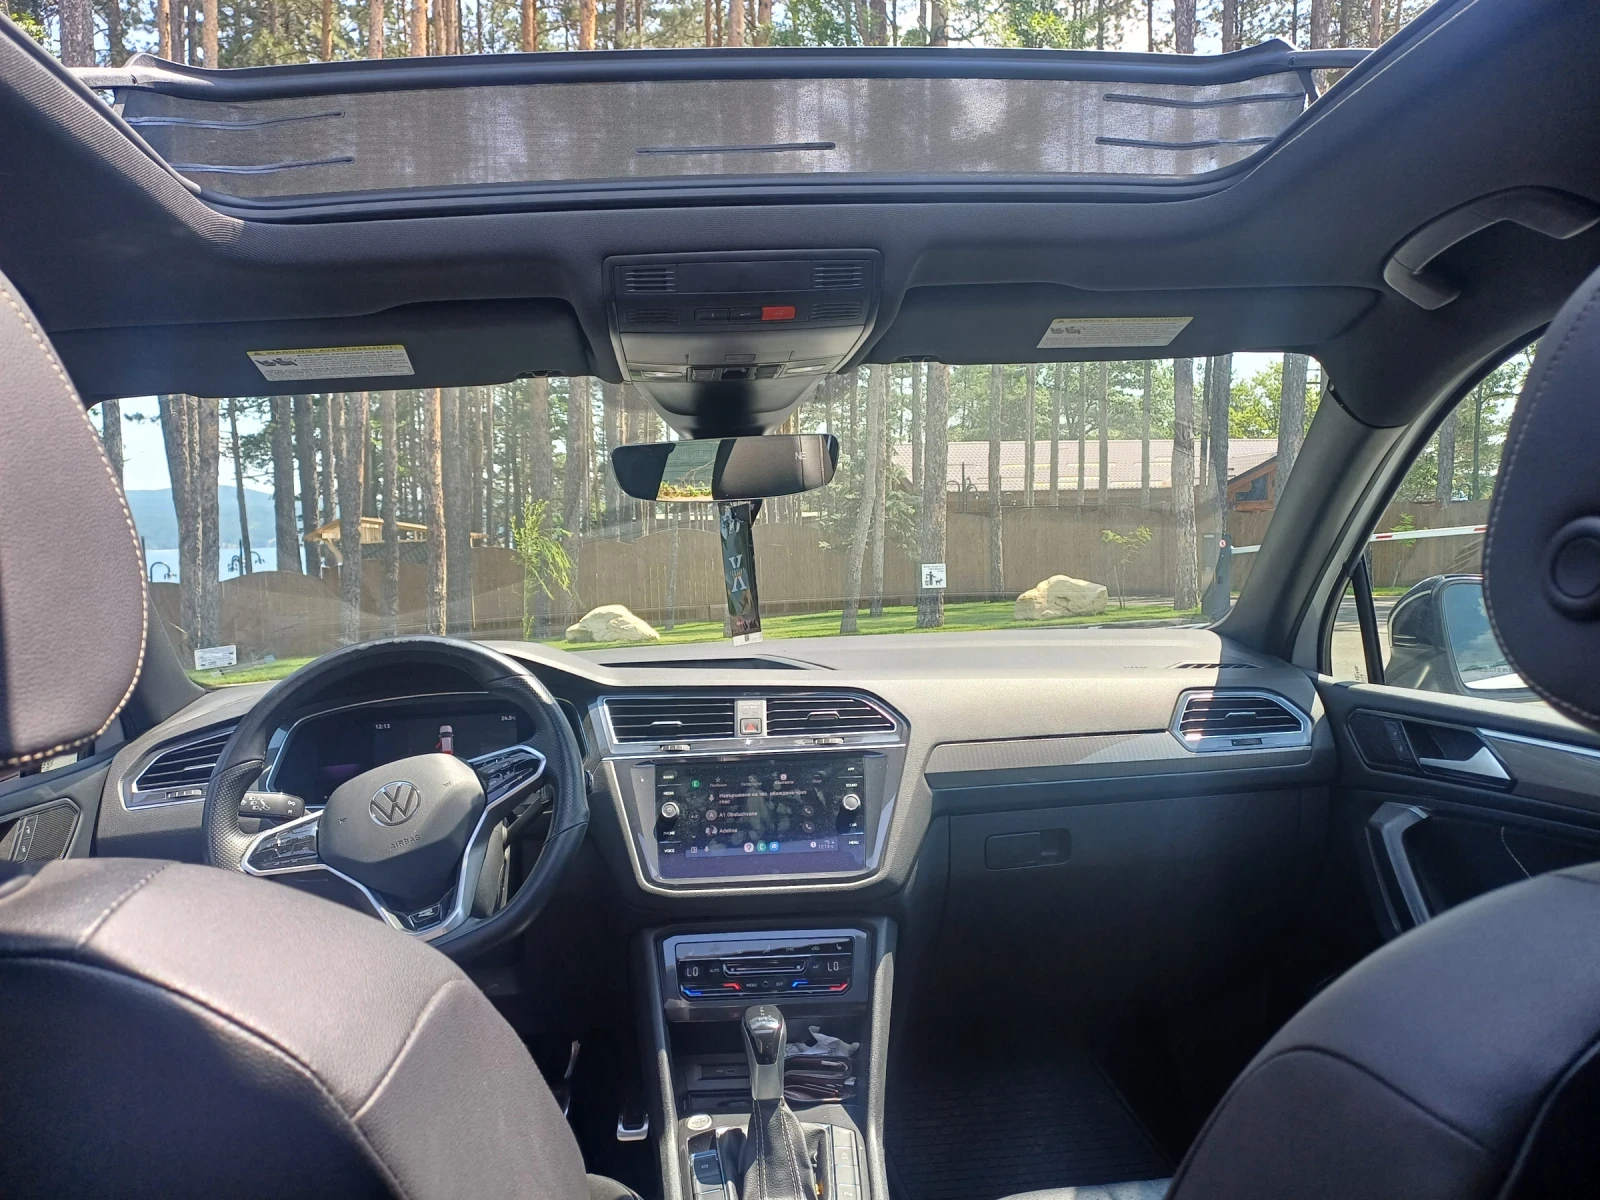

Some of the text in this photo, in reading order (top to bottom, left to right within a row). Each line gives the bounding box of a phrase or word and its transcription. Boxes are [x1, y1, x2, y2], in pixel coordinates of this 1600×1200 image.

[795, 452, 807, 460] NE
[389, 834, 421, 851] AIRBAG
[686, 966, 699, 977] LO
[827, 961, 840, 972] LO
